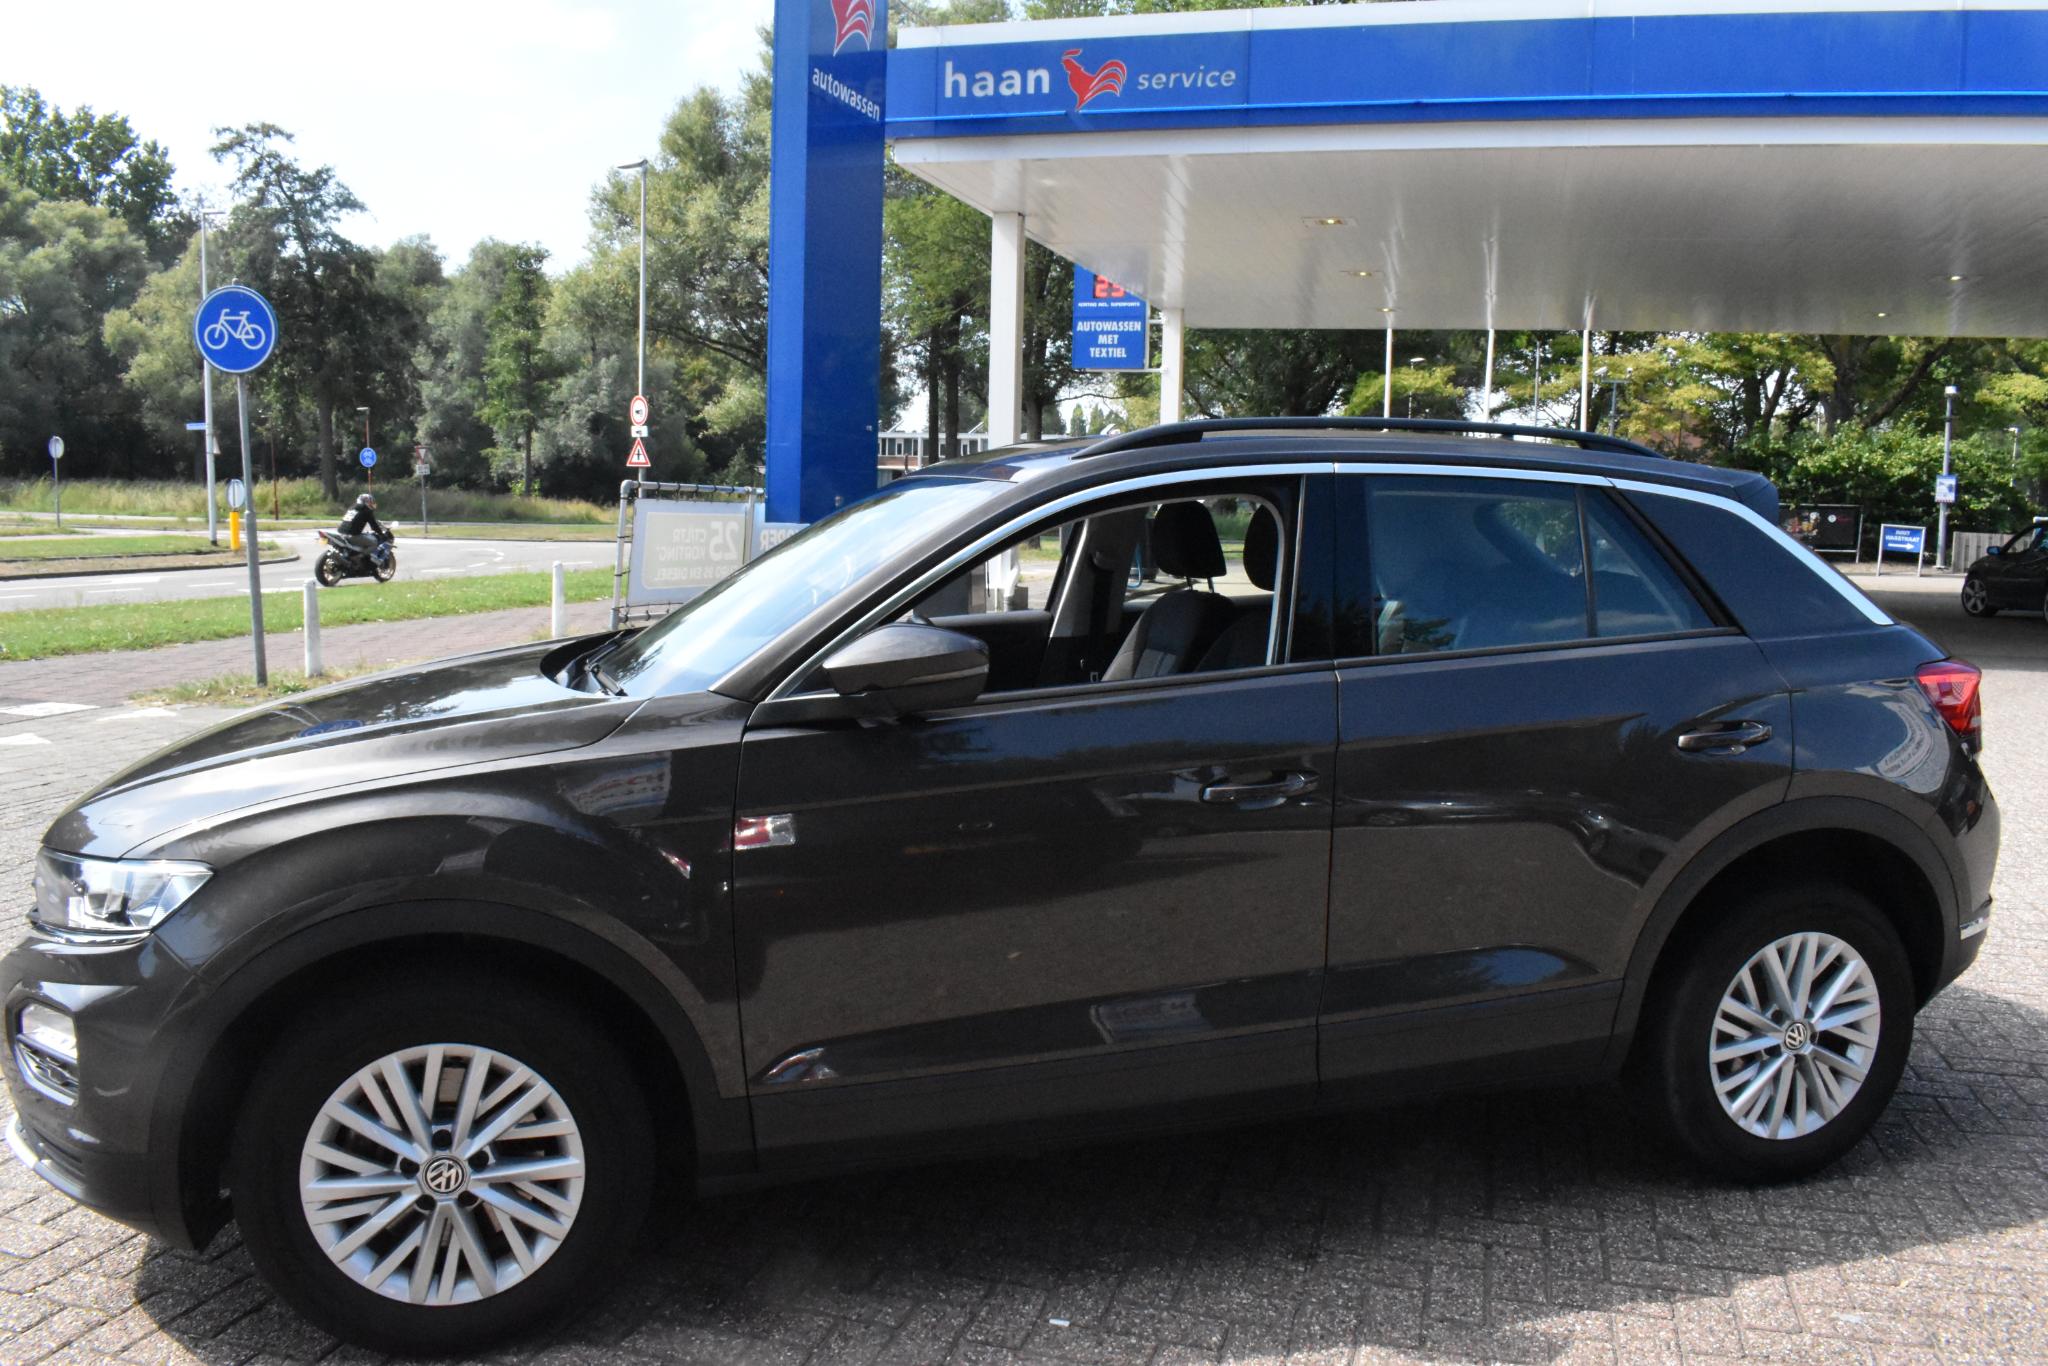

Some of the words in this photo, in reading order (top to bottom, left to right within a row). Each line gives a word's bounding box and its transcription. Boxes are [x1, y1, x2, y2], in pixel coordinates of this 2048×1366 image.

[944, 61, 1050, 98] haan
[1137, 64, 1236, 91] service
[812, 67, 881, 122] autowassen
[1077, 321, 1141, 332] AUTOWASSEN
[1098, 334, 1119, 345] MET
[1089, 347, 1127, 358] TEXTIEL
